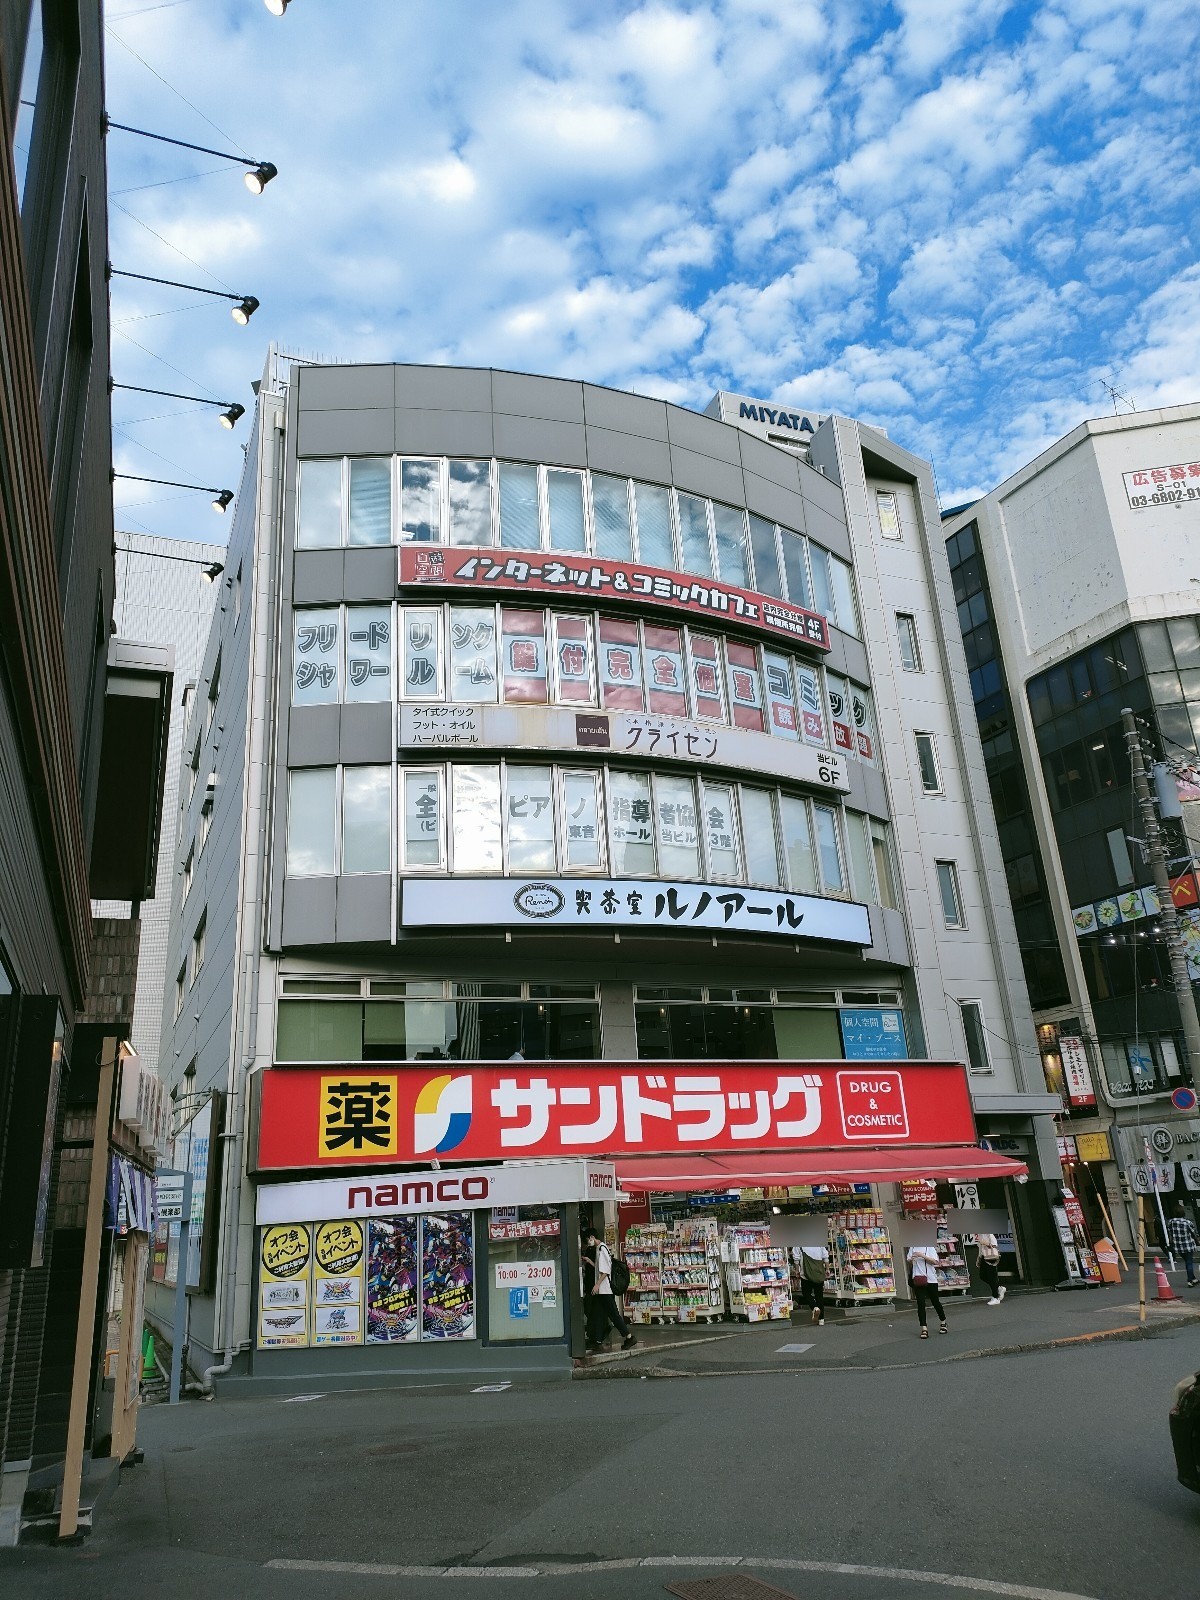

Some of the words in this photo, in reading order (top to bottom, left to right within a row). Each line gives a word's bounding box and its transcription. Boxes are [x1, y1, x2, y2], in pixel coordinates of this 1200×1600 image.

[739, 402, 815, 433] MIYATA
[453, 556, 760, 620] インターネット&コミックカフェ
[808, 618, 820, 631] 4F
[412, 707, 474, 717] タイ式クイック
[412, 721, 476, 730] フット・オイル
[412, 734, 479, 743] ハーバルボール
[625, 727, 718, 759] クライセン
[816, 752, 838, 766] 当ビル
[818, 766, 841, 785] 6F
[850, 1081, 892, 1093] DRUG
[869, 1098, 878, 1109] &
[1078, 1095, 1088, 1103] 2F
[325, 1081, 392, 1150] 薬
[491, 1074, 824, 1147] サンドラッグ
[847, 1114, 903, 1127] COSMETIC
[588, 1173, 613, 1189] namco
[348, 1176, 489, 1209] namco
[903, 1193, 937, 1203] サンドラッグ
[498, 1270, 518, 1279] 10:00
[528, 1266, 553, 1279] 23:00
